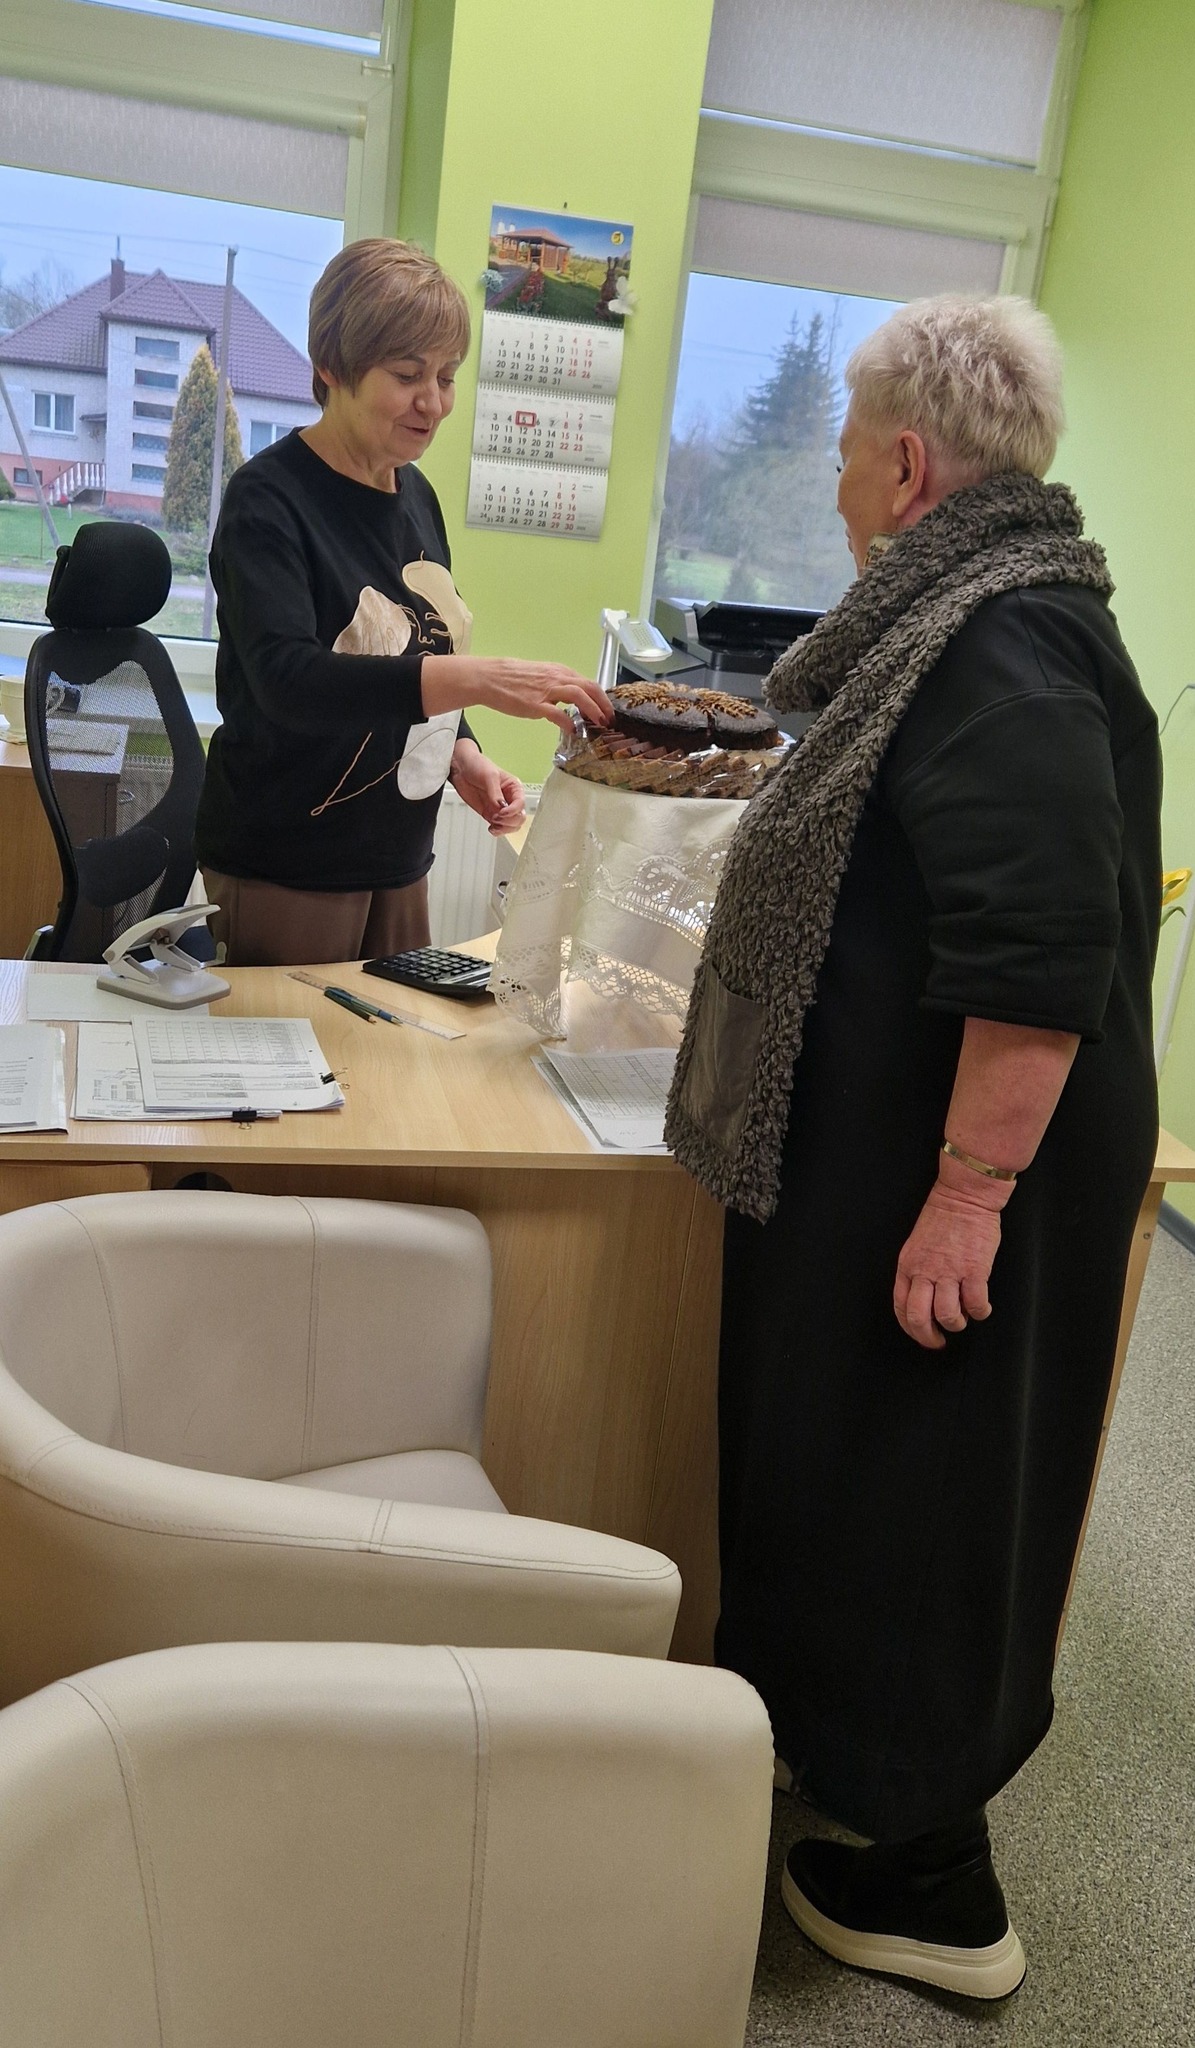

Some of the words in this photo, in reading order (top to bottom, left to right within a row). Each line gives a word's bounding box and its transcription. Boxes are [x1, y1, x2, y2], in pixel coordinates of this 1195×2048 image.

[510, 362, 519, 370] 21
[520, 427, 528, 435] 12
[547, 430, 556, 438] 14
[531, 439, 541, 447] 20
